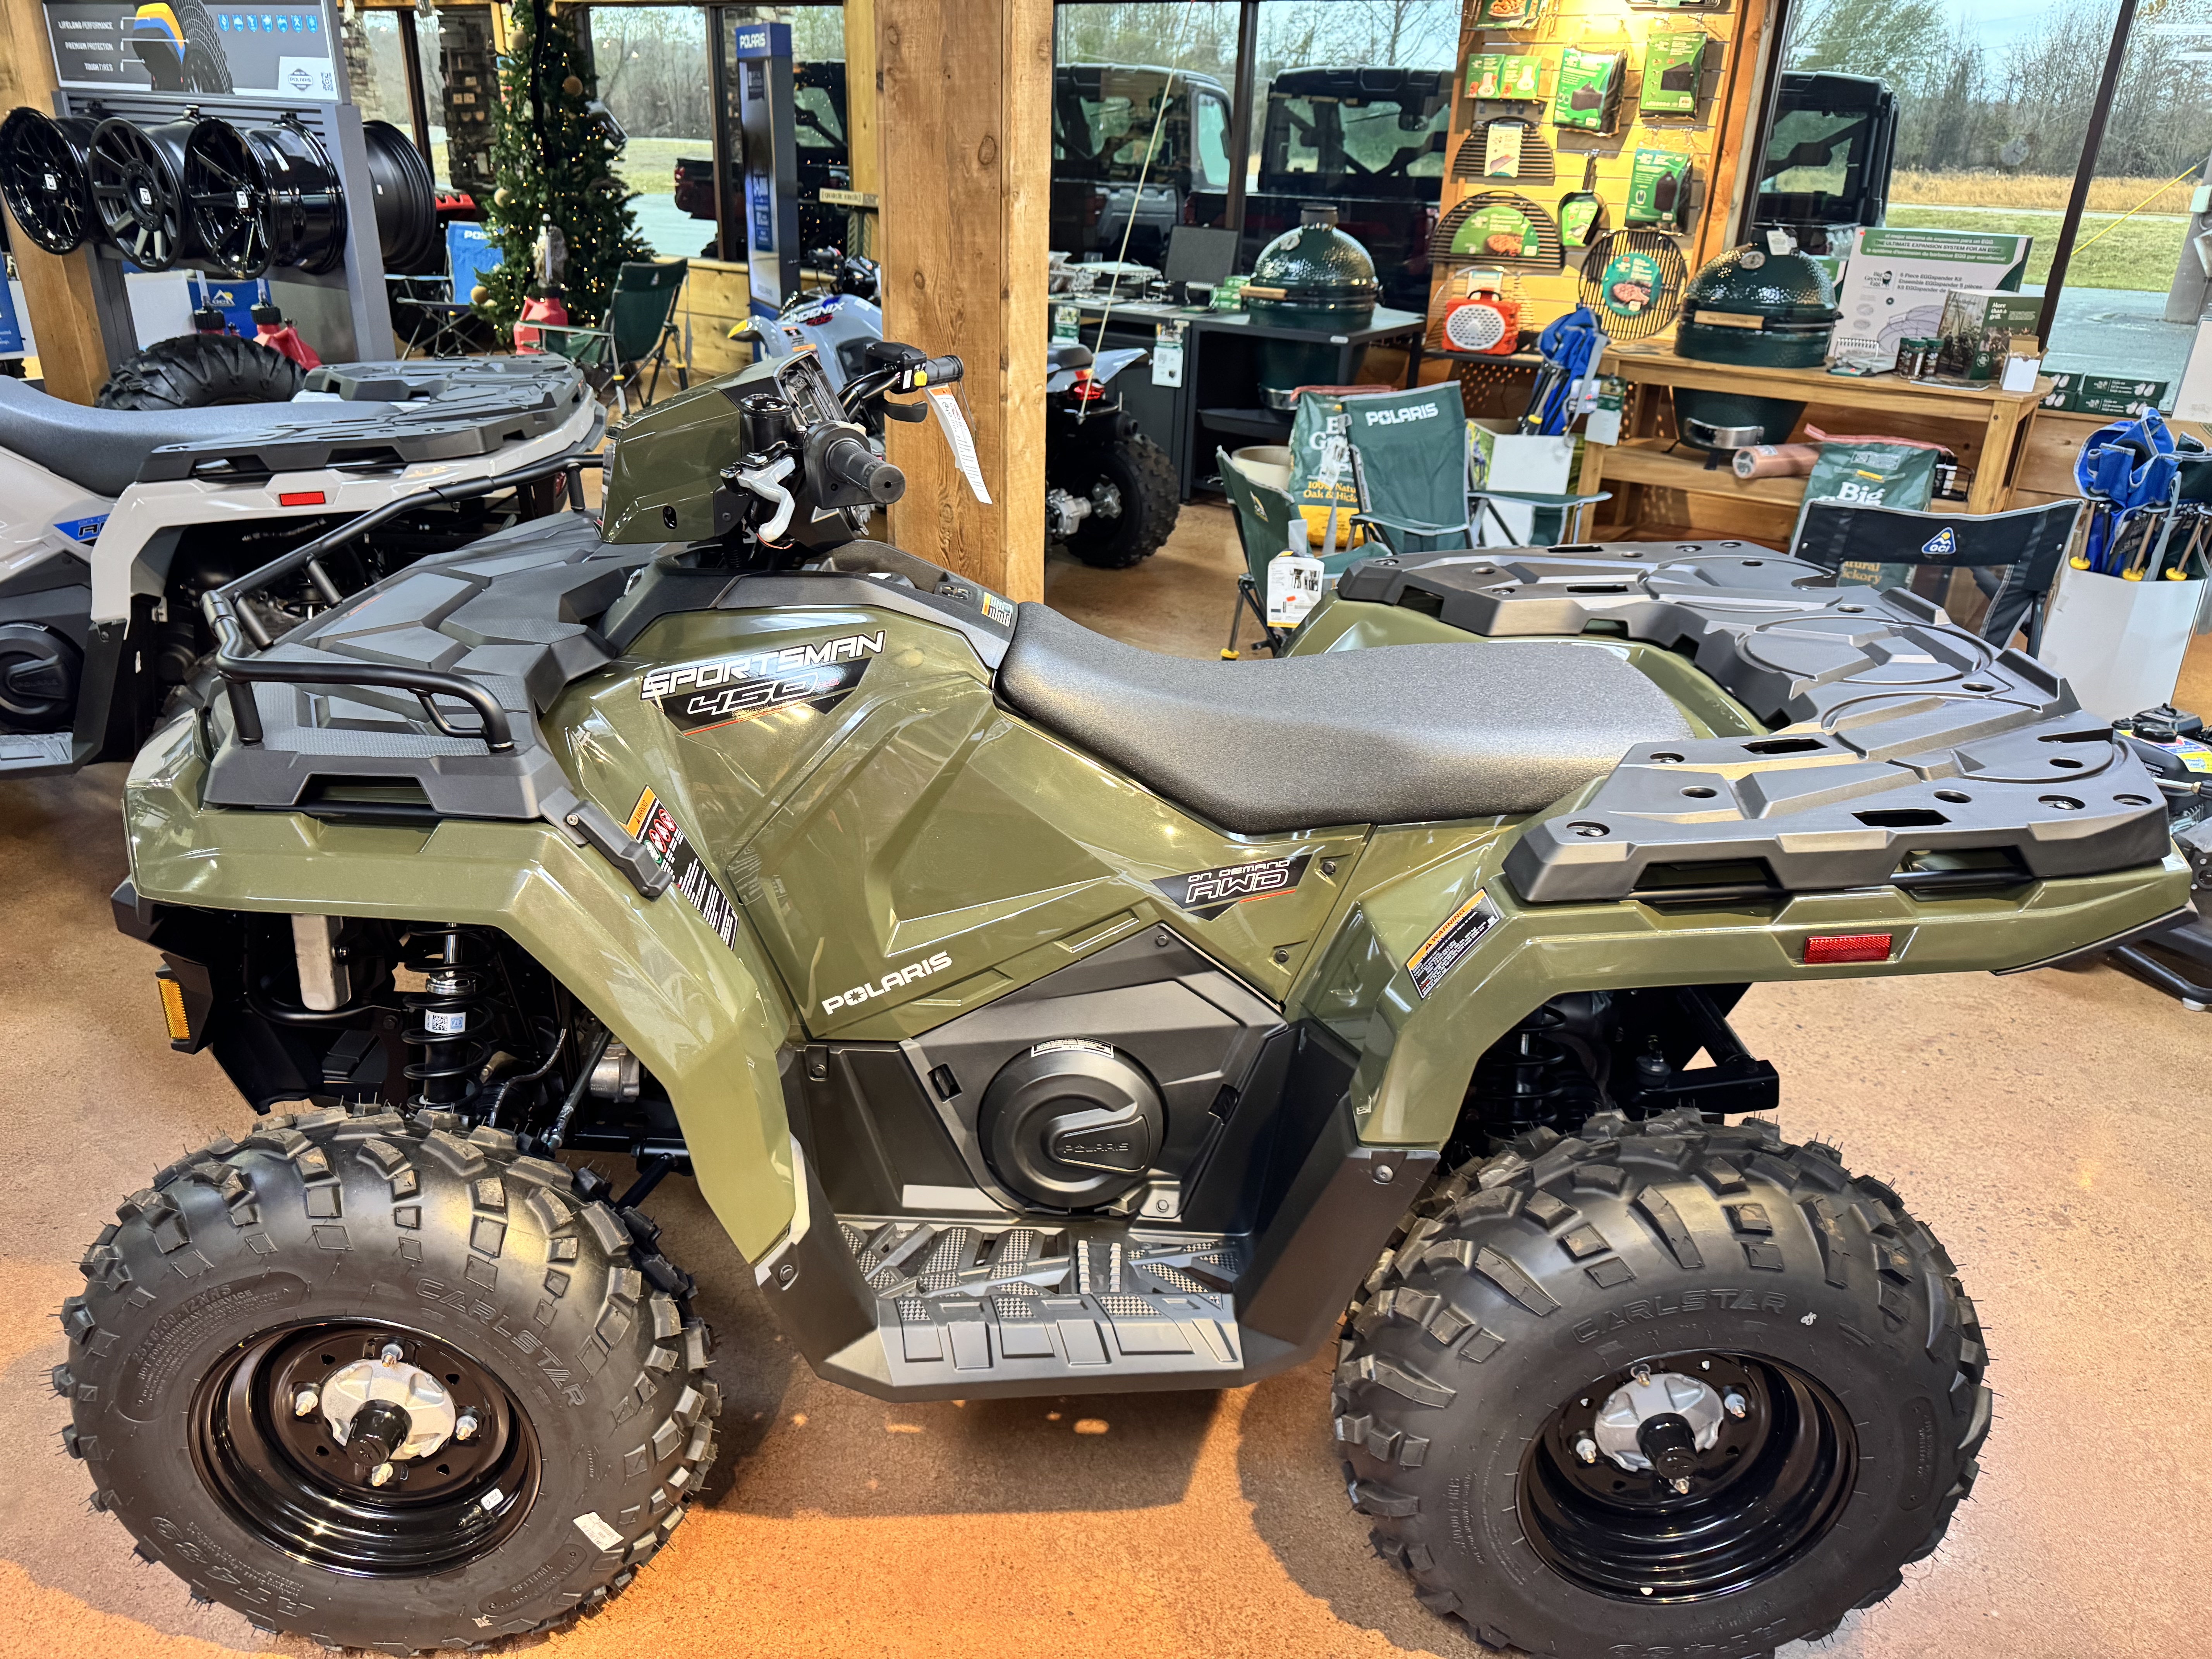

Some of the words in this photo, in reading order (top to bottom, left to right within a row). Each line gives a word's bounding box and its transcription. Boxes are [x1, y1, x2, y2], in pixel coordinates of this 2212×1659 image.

[81, 21, 113, 30] PERFORMANCE
[65, 42, 87, 50] PREMIUM
[86, 42, 113, 50] PROTECTION
[739, 32, 766, 49] POLARIS
[98, 63, 113, 72] TIRES
[1365, 403, 1439, 426] POLARIS
[1304, 489, 1324, 499] Oak
[1336, 483, 1356, 493] Natu
[1837, 482, 1886, 505] Big
[1929, 544, 1950, 553] GCI
[1842, 569, 1882, 584] ickory
[1843, 561, 1881, 572] atural
[641, 630, 886, 700] SPORTSMAN
[687, 672, 819, 716] 450
[1188, 872, 1212, 883] ON
[1219, 860, 1290, 878] DEMAND
[1185, 868, 1289, 903] AWD
[1431, 908, 1466, 941] WARNING
[822, 950, 953, 1015] POLARIS
[1063, 1142, 1129, 1153] POLARIS
[1571, 1289, 1789, 1343] CARLSTAR
[135, 1360, 152, 1381] NOT
[147, 1341, 166, 1361] FOR
[161, 1308, 203, 1345] HIGHWAY
[204, 1286, 253, 1312] SERVICE
[416, 1278, 587, 1407] CARLSTAR
